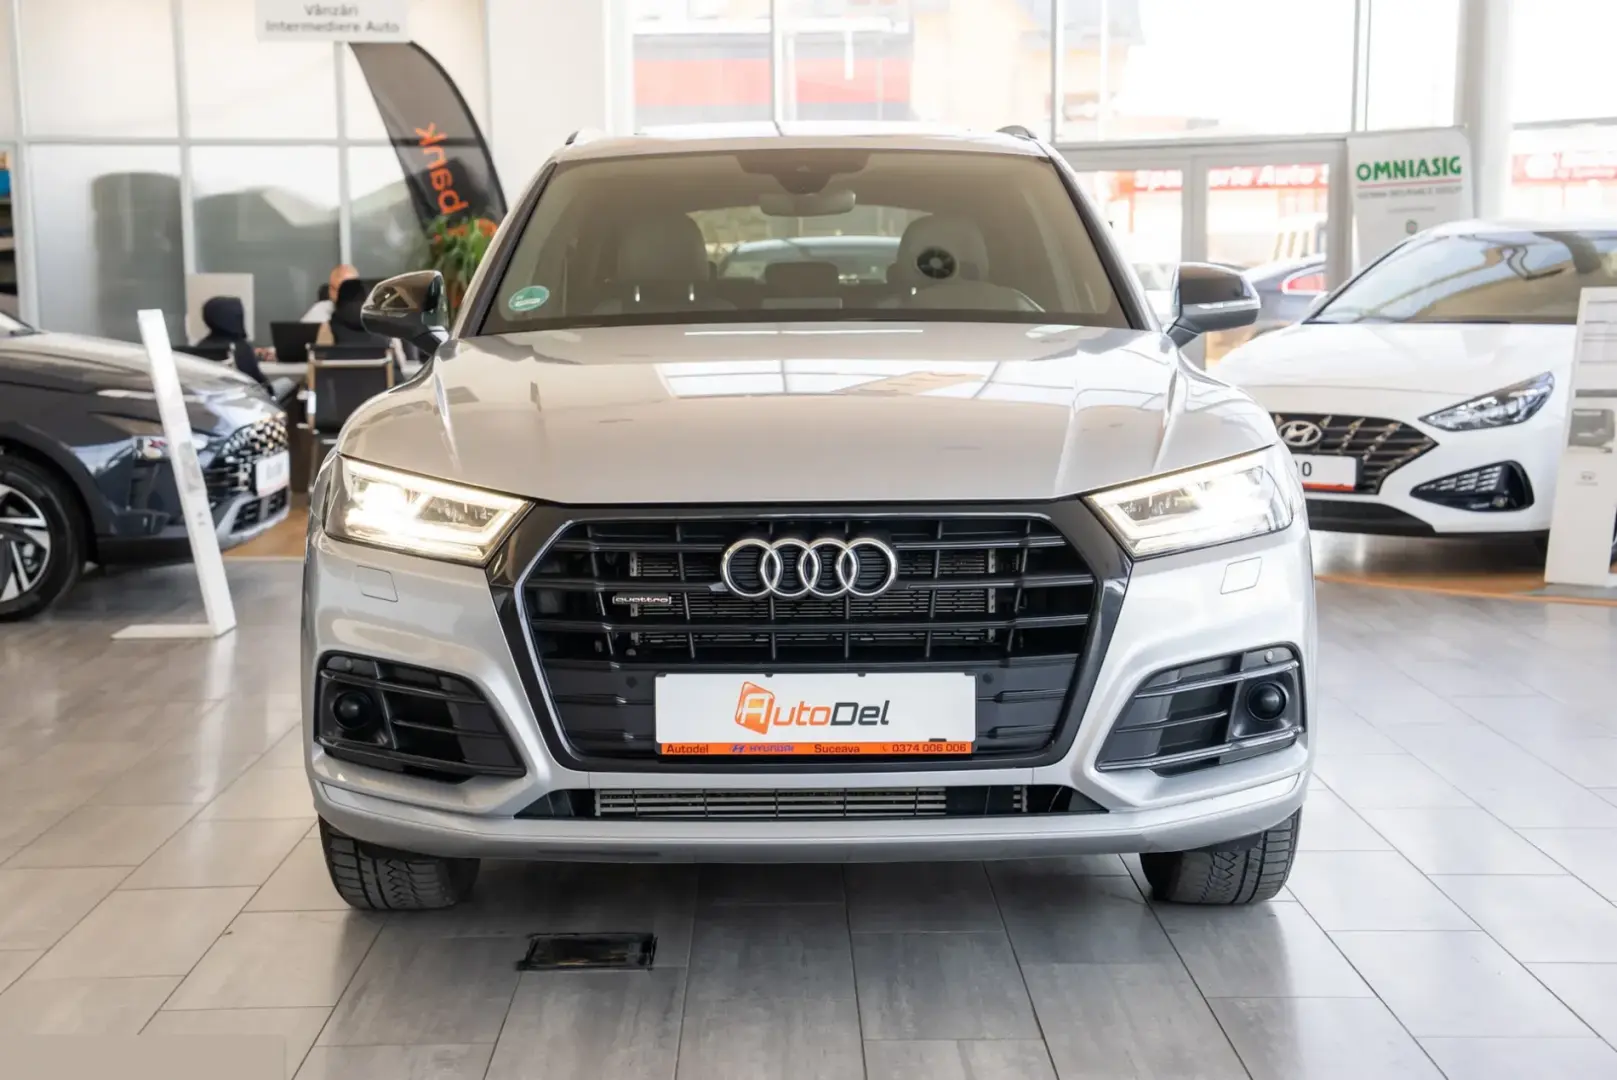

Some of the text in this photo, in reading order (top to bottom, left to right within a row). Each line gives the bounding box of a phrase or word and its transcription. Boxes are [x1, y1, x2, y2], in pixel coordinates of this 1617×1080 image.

[265, 20, 400, 32] Intermediere Auto
[1356, 156, 1462, 181] OMNIASIG
[614, 596, 670, 604] quattro
[738, 690, 890, 728] AutoDel
[666, 743, 967, 753] Autodel HYUNDAI Suceava 0374 006 006
